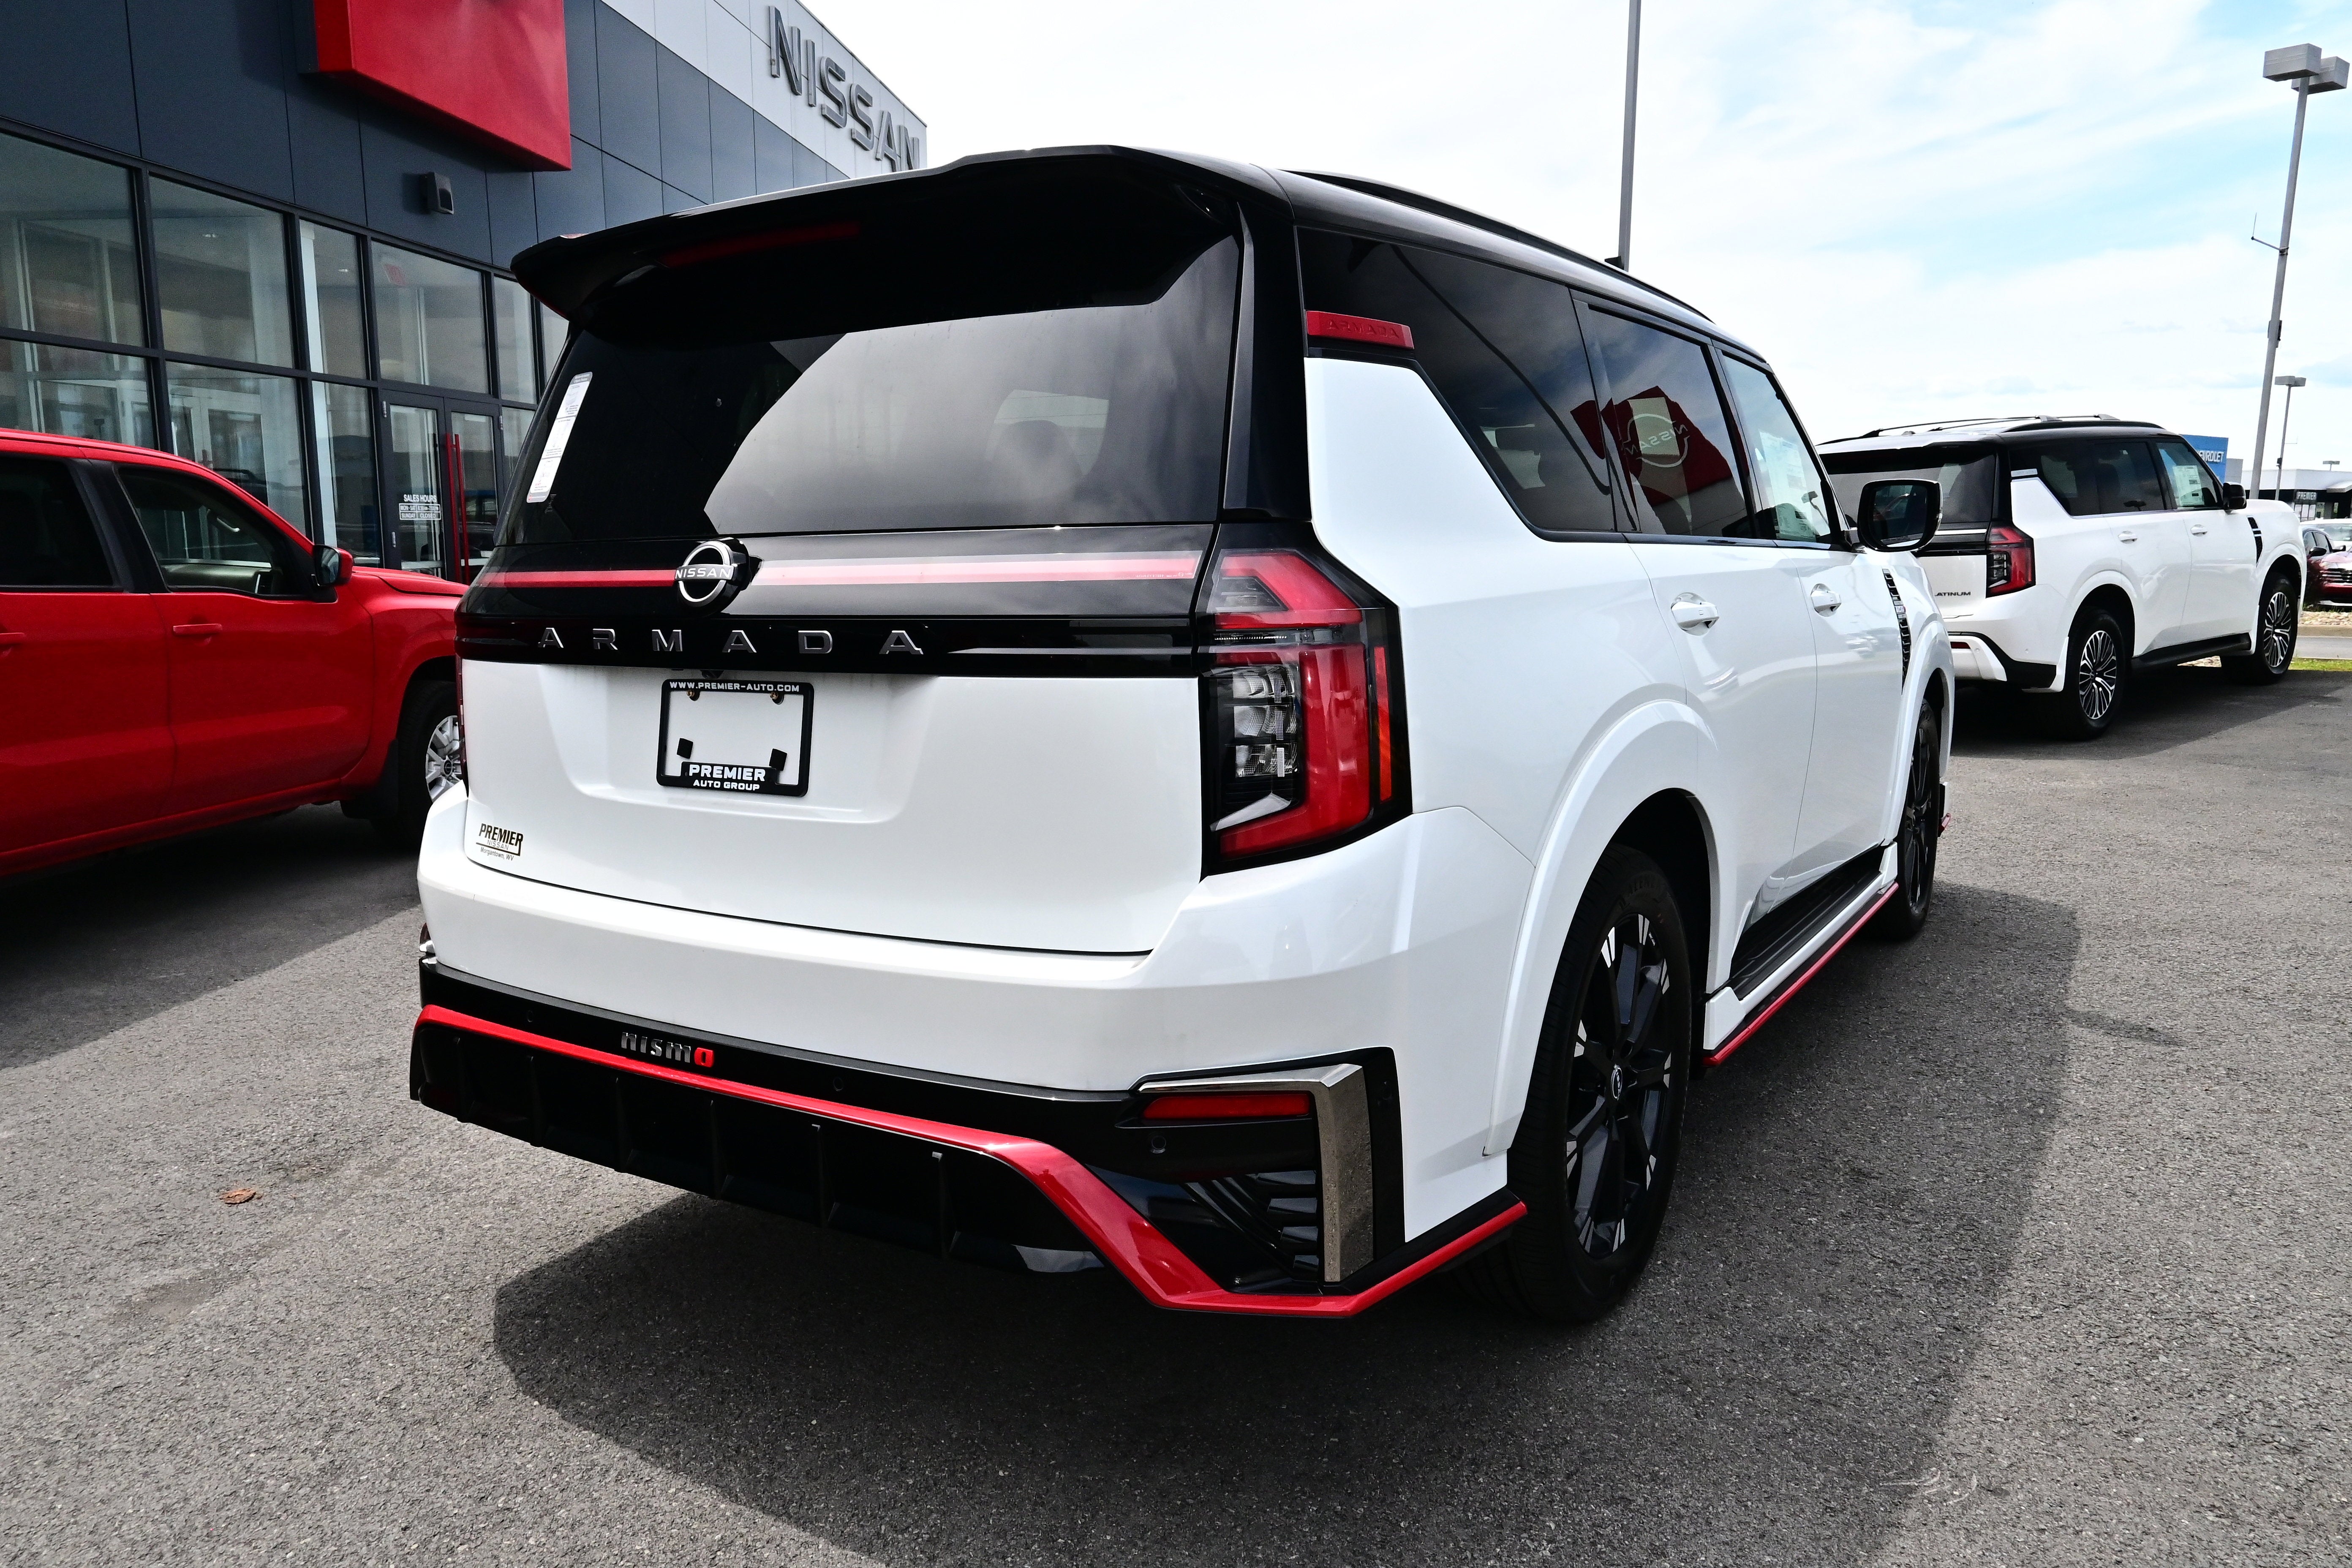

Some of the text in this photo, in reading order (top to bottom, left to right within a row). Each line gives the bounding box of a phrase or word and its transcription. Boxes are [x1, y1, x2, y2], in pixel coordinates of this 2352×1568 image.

[769, 5, 920, 172] NISSAN
[2196, 450, 2224, 462] EVROLET
[420, 495, 437, 503] HOURS
[675, 567, 731, 579] NISSAN
[537, 627, 924, 655] ARMADA
[670, 681, 800, 692] WWW.PREMIER-AUTO.COM
[689, 764, 766, 782] PREMIER
[693, 779, 760, 791] AUTO GROUP
[479, 823, 523, 847] PREMIER
[487, 839, 509, 850] NISSAN
